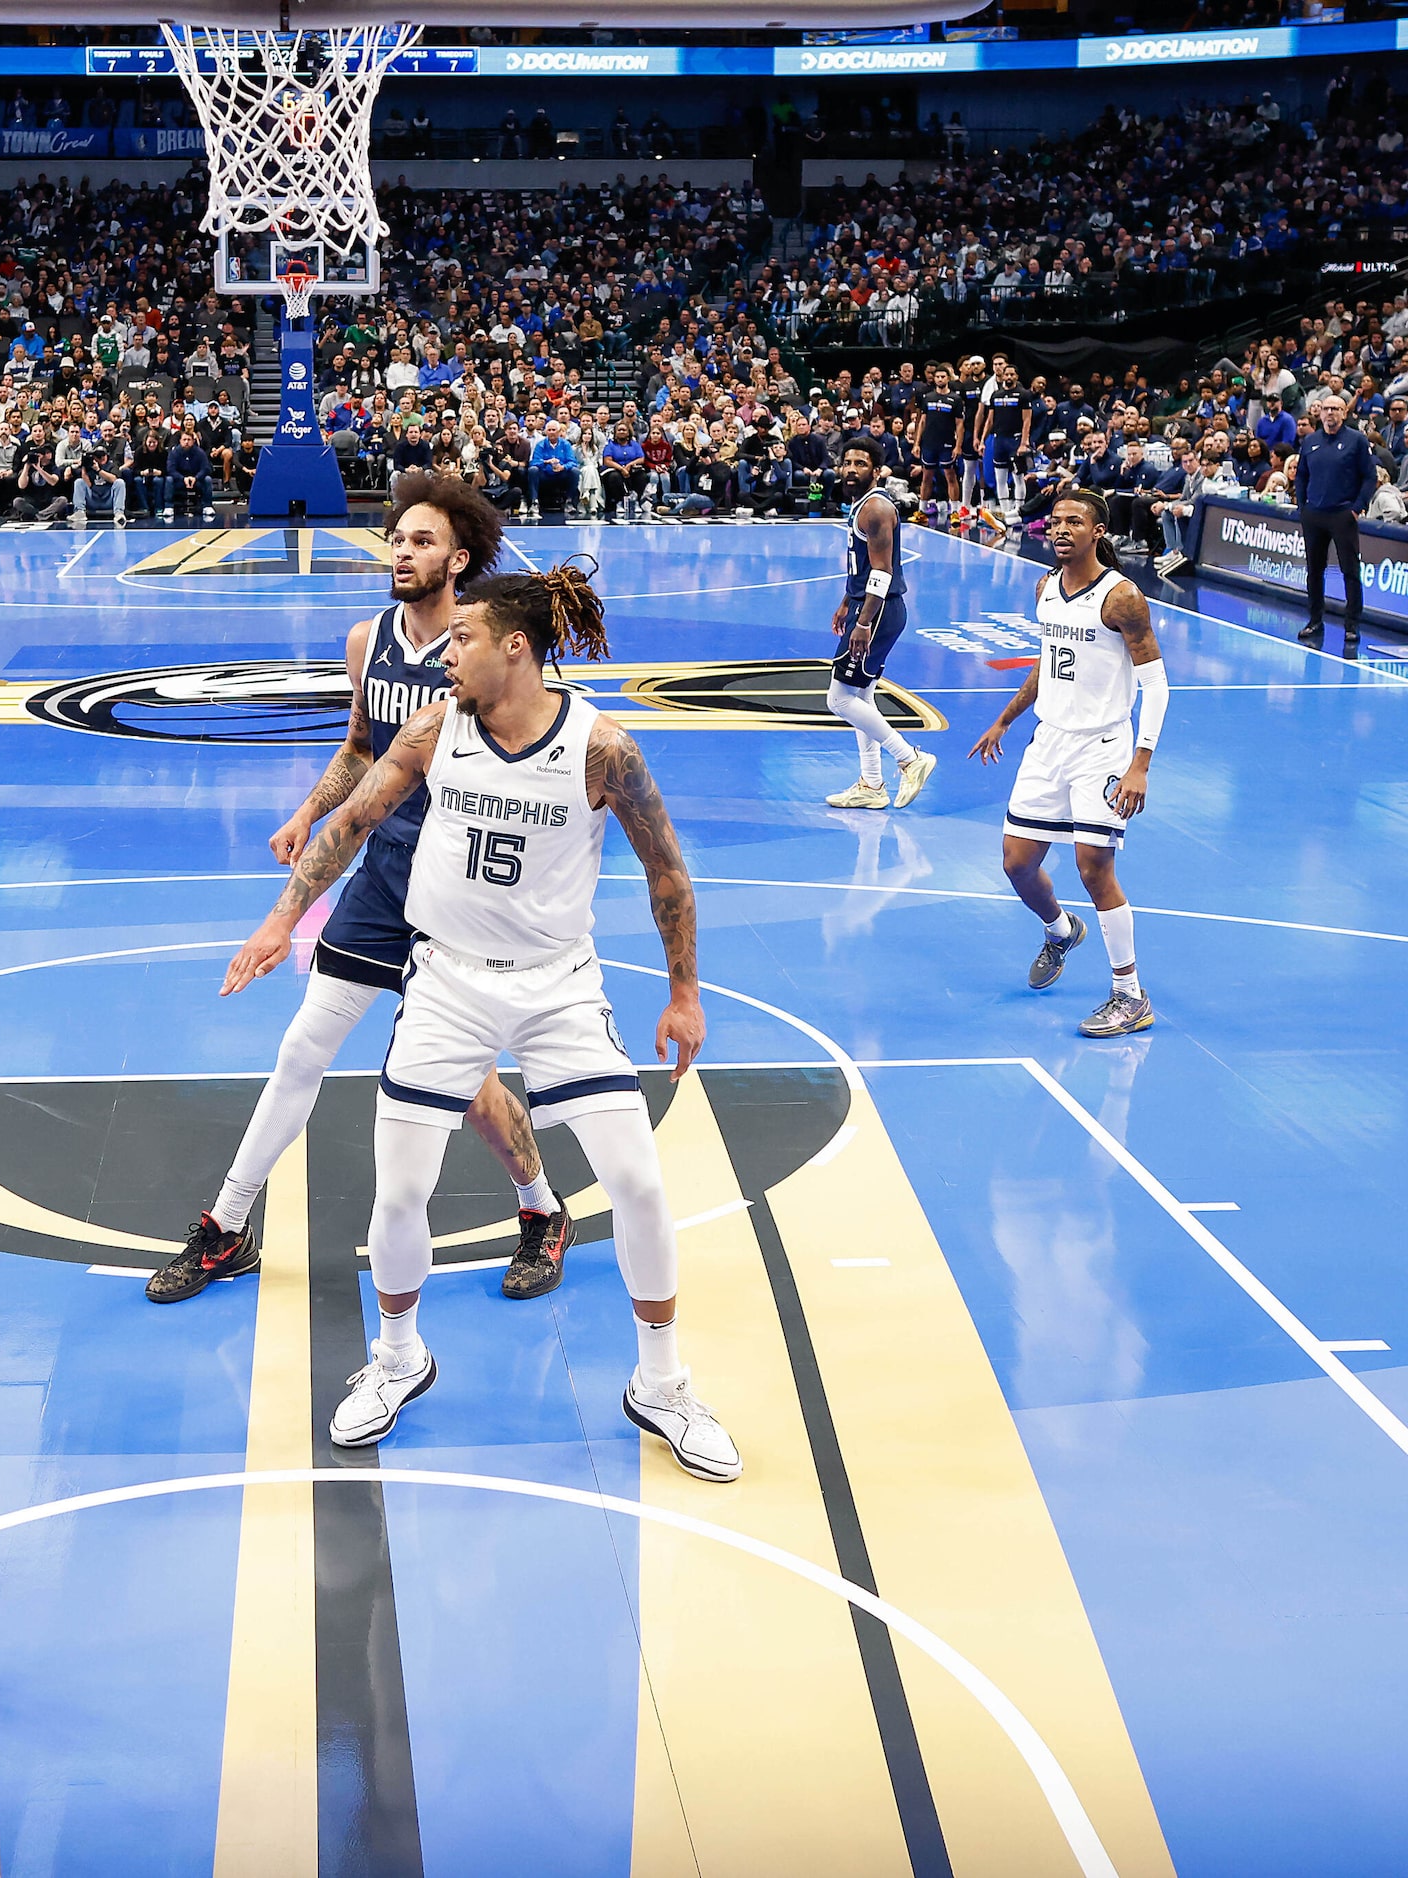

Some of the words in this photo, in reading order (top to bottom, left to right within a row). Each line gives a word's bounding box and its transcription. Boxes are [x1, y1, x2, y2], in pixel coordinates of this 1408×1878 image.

[1123, 38, 1259, 60] DOCUMATION
[107, 60, 117, 72] 7
[146, 60, 156, 72] 2
[412, 60, 420, 72] 1
[449, 60, 458, 72] 7
[522, 53, 649, 70] DOCUMATION
[817, 52, 947, 69] DOCUMATION
[287, 382, 309, 390] AT&T
[281, 421, 313, 439] Kroger
[1248, 553, 1284, 579] Medical
[1049, 645, 1076, 682] 12
[536, 766, 572, 776] Robinhood
[441, 785, 569, 828] MEMPHIS
[465, 825, 527, 888] 15
